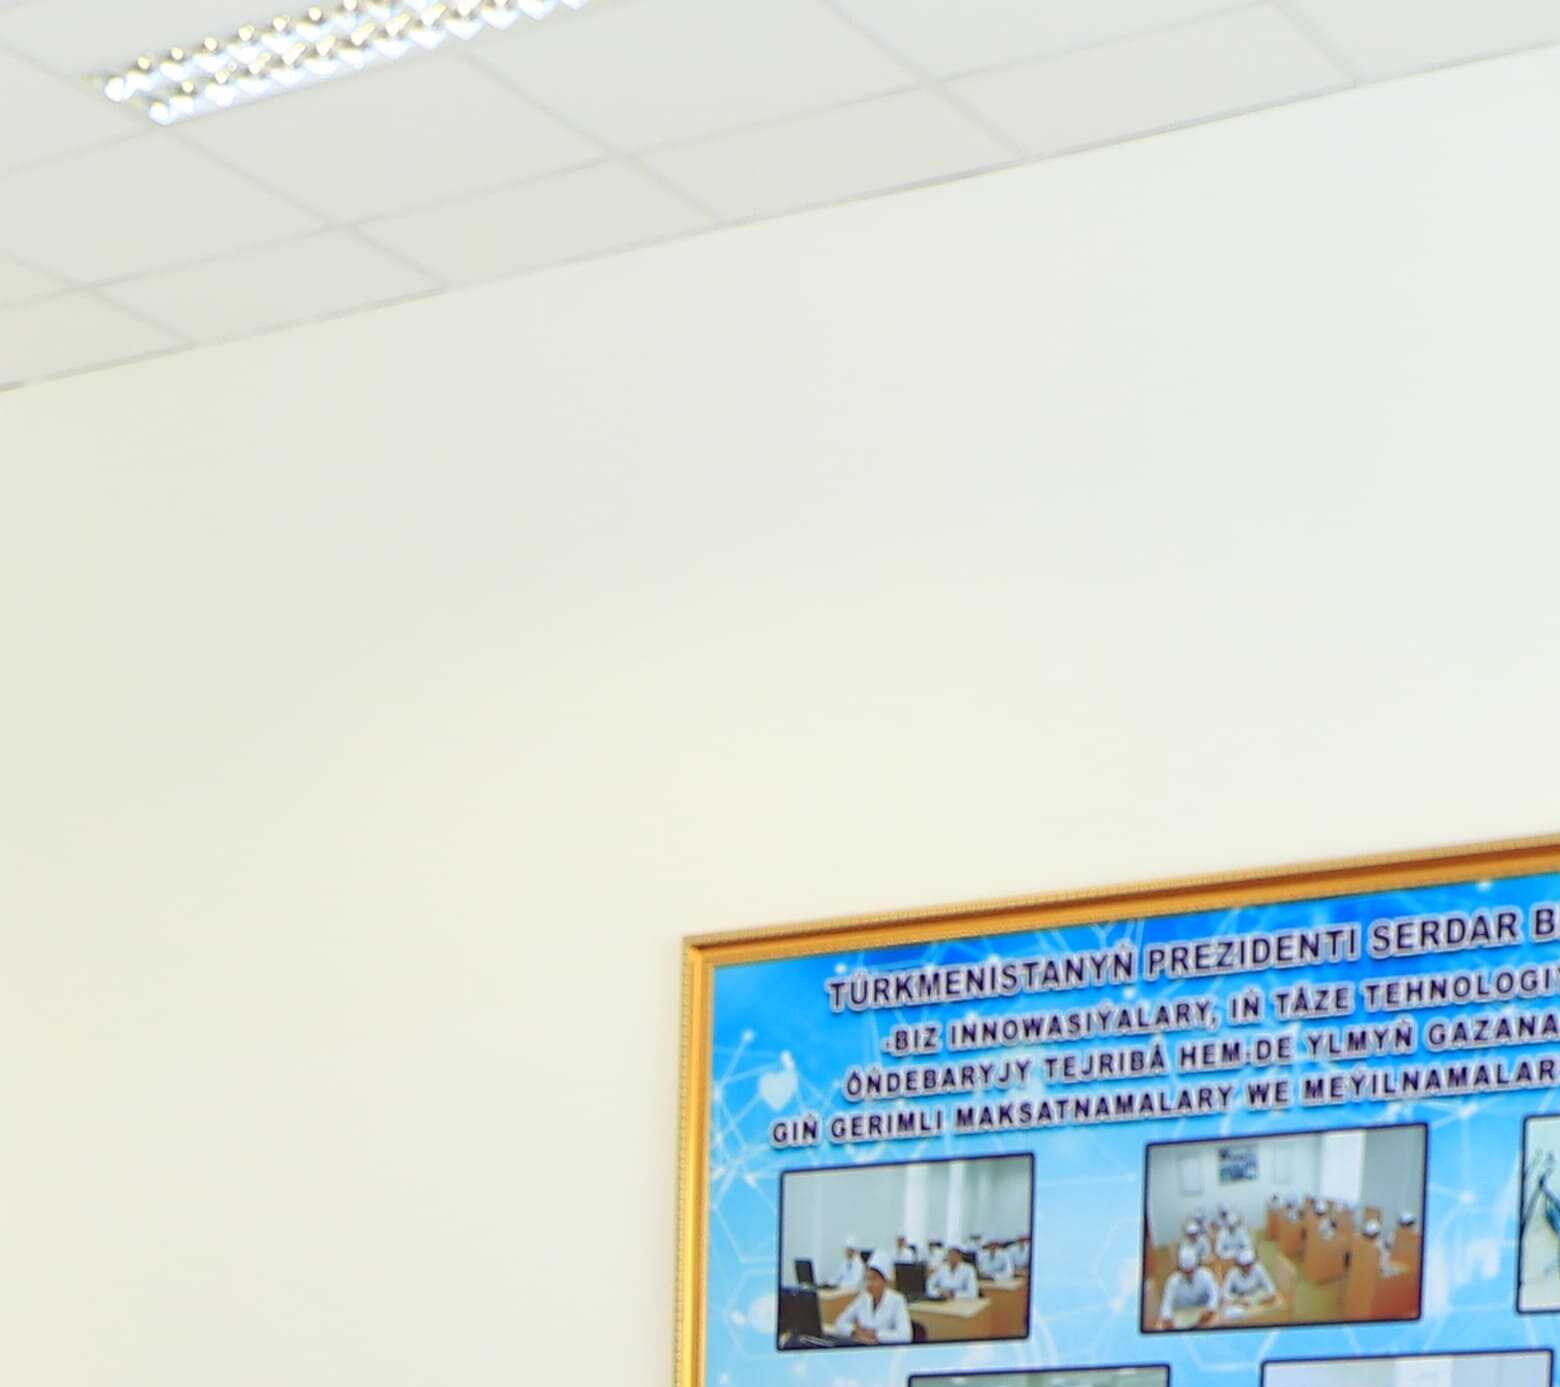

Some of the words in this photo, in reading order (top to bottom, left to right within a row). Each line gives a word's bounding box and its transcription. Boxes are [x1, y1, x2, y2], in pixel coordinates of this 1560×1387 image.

[1147, 928, 1358, 976] PREZIDENTI
[1372, 911, 1519, 951] SERDAR
[1276, 983, 1351, 1016] TÄZE
[831, 1110, 944, 1139] GERIMLI
[956, 1085, 1233, 1128] MAKSATNAMALARY
[1247, 1080, 1289, 1104] WE
